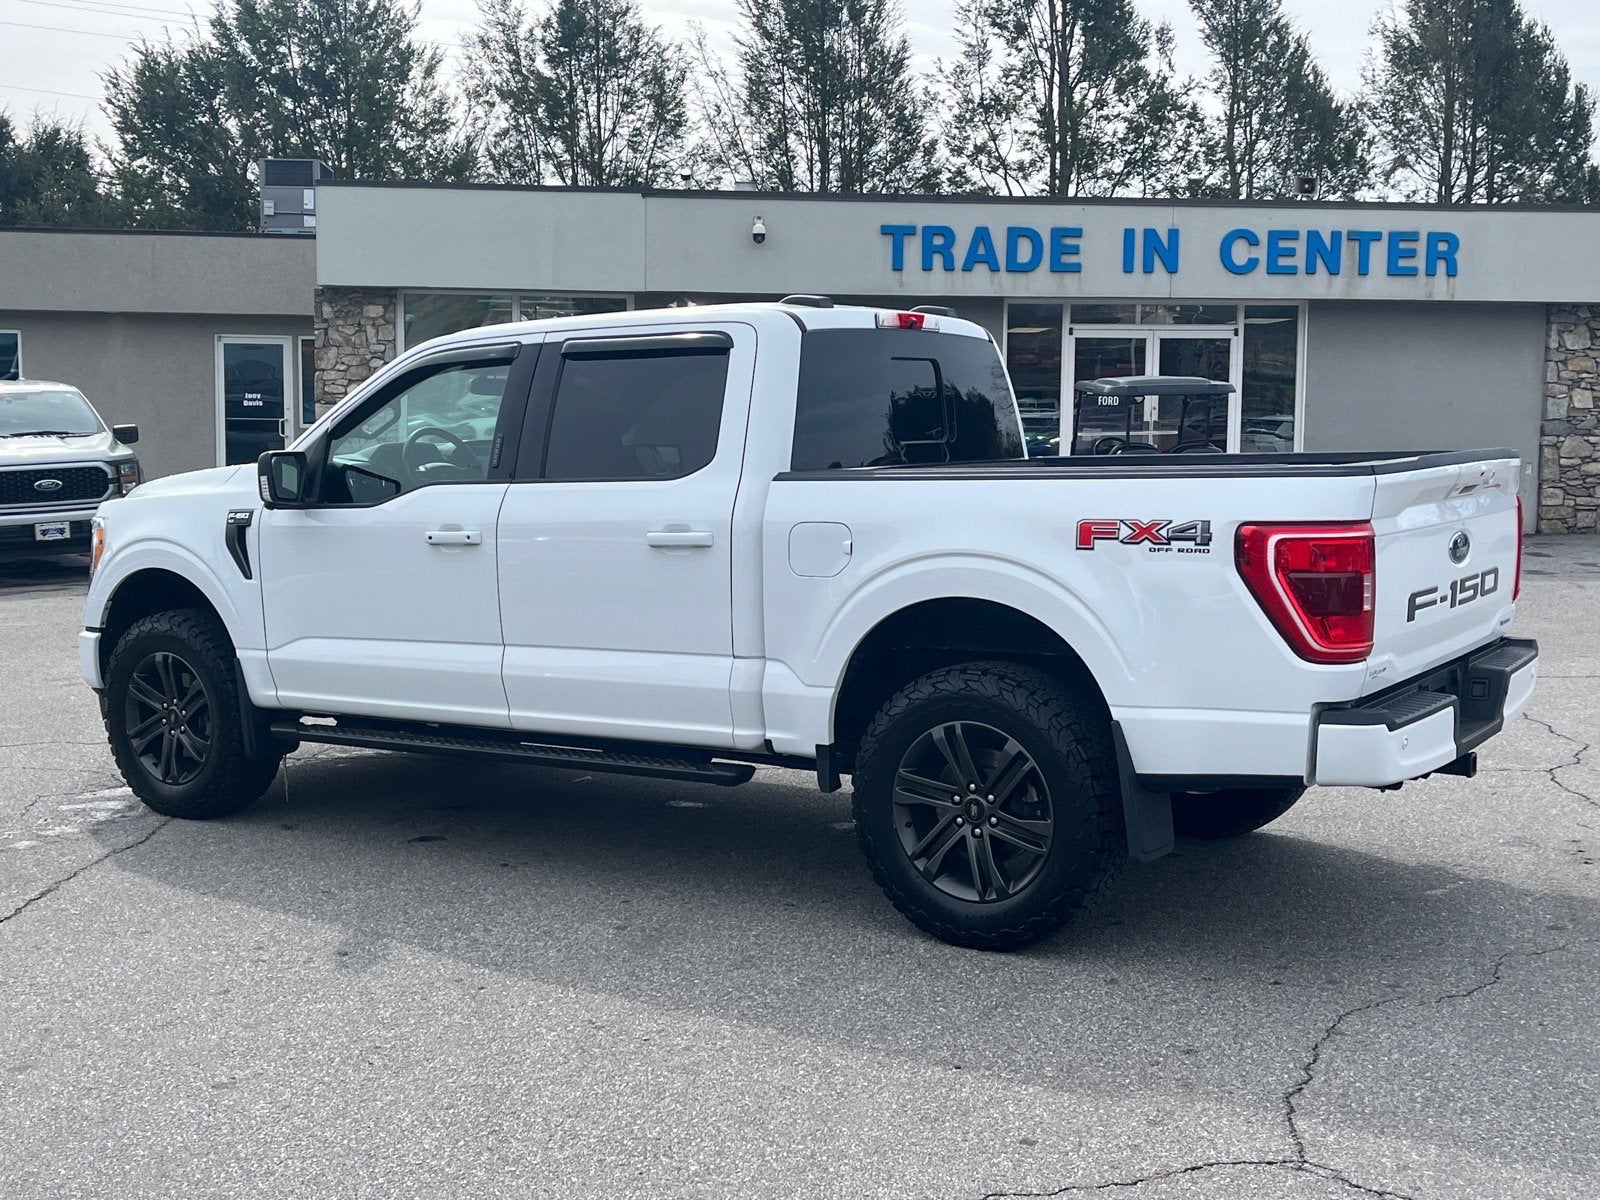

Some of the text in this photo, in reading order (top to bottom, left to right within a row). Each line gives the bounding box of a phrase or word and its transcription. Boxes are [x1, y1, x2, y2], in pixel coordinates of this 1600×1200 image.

[880, 224, 1461, 277] TRADE IN CENTER
[1097, 396, 1119, 406] FORD
[1076, 519, 1212, 550] FX4
[1406, 566, 1499, 623] F-150
